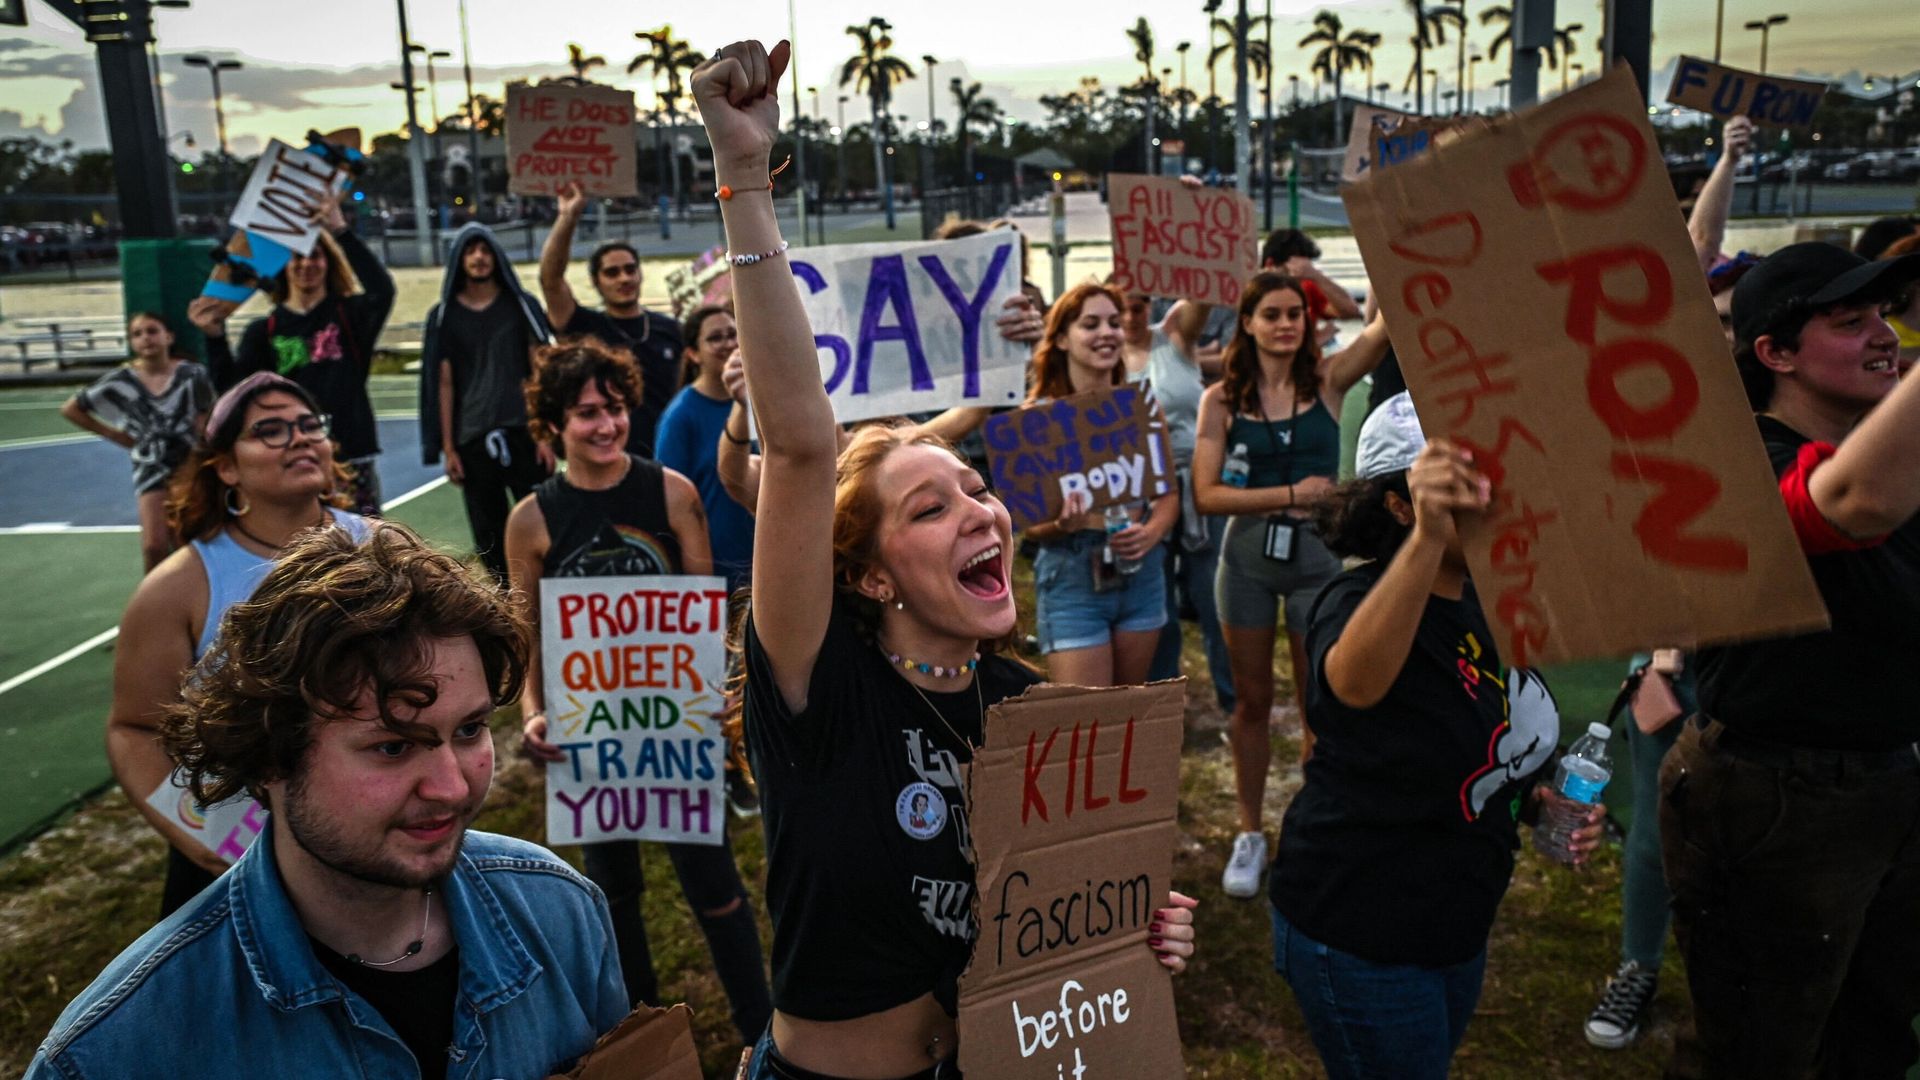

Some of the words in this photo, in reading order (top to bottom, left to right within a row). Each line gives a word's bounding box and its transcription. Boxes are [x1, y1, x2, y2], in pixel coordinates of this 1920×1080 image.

[518, 95, 558, 123] HE
[567, 97, 630, 127] DOES
[1676, 61, 1710, 98] F
[1711, 72, 1746, 115] U
[1749, 80, 1819, 126] RON
[533, 124, 607, 149] NOT
[247, 146, 338, 236] VOTE
[514, 152, 621, 178] PROTECT
[1192, 192, 1250, 233] YOU
[1113, 213, 1258, 272] FASCISTS
[1113, 254, 1211, 300] BOUND
[1389, 209, 1520, 431] Death
[1534, 242, 1749, 573] RON
[558, 589, 728, 640] PROTECT
[561, 643, 704, 693] QUEER
[584, 694, 681, 735] AND
[557, 737, 717, 783] TRANS
[1021, 715, 1148, 826] KILL
[555, 786, 711, 839] YOUTH
[993, 870, 1151, 967] fascism
[1012, 979, 1131, 1059] before
